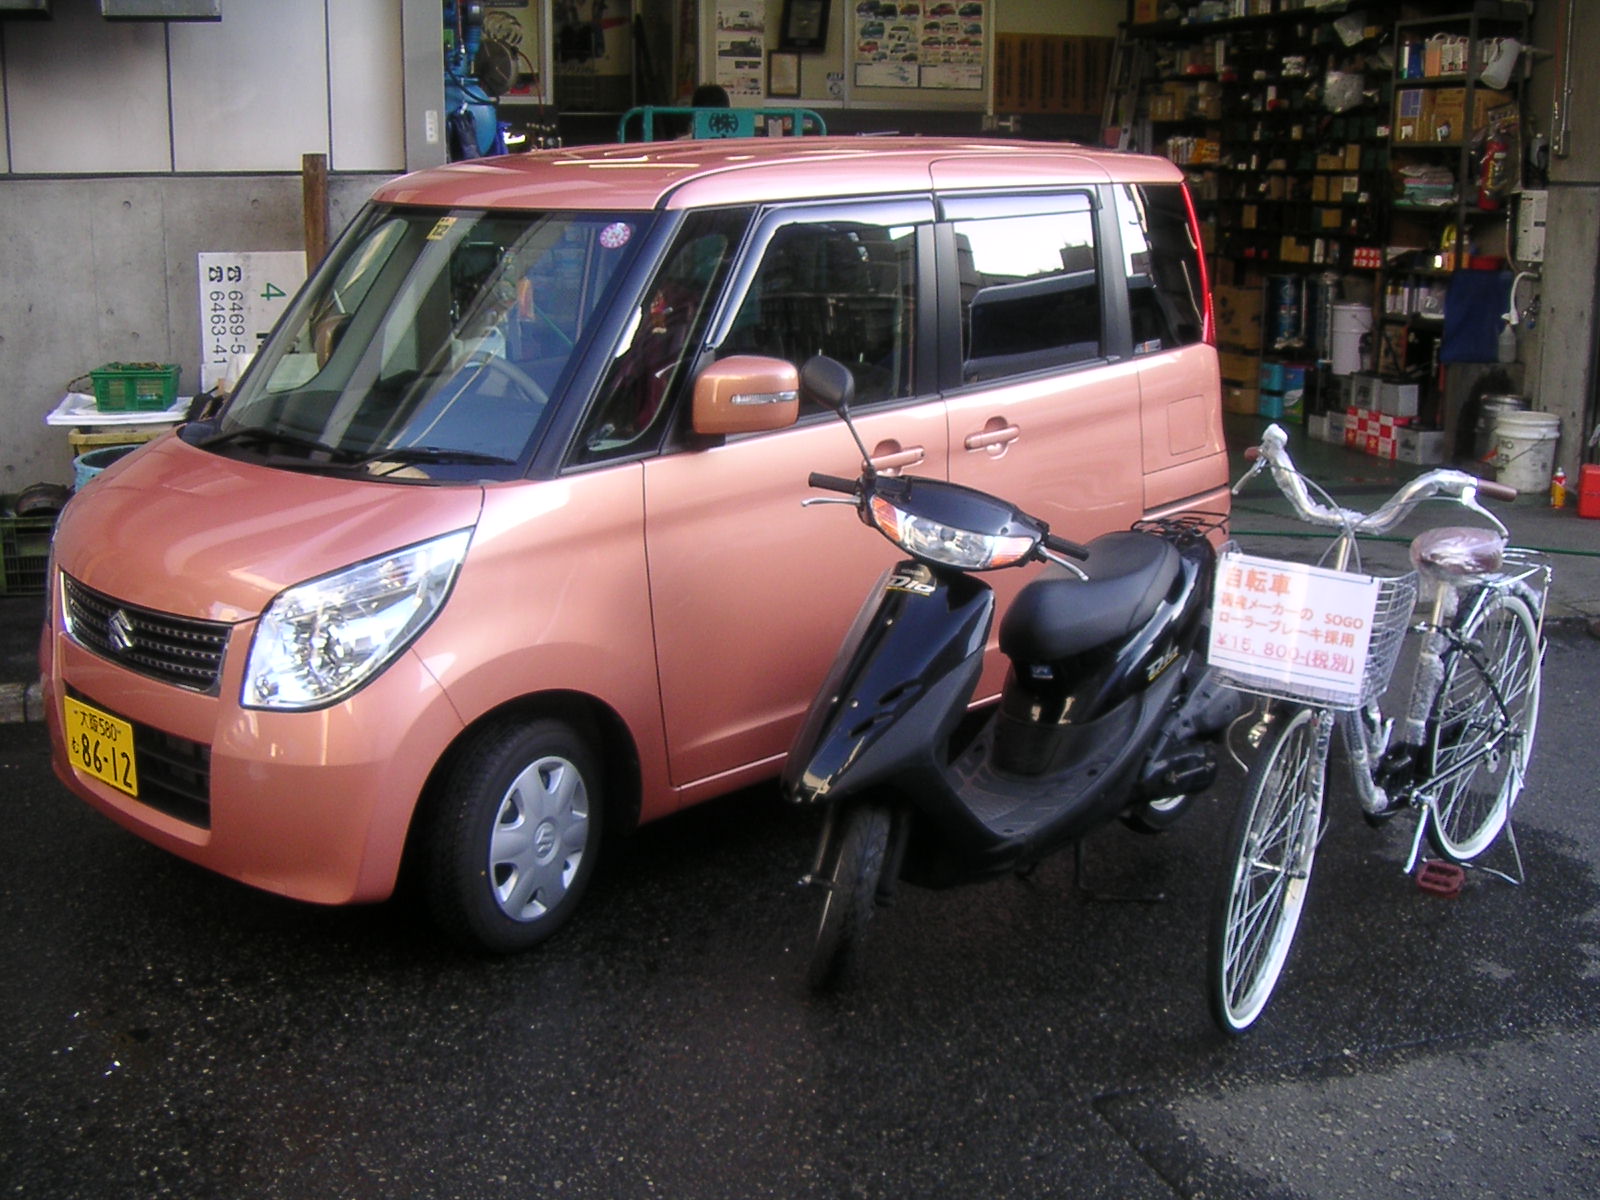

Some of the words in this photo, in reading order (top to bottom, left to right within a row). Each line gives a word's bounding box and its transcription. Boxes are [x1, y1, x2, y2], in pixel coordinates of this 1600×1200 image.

[261, 283, 287, 301] 4
[1225, 567, 1292, 597] 自転車
[1324, 612, 1364, 630] SOGO
[81, 733, 133, 789] 86-12
